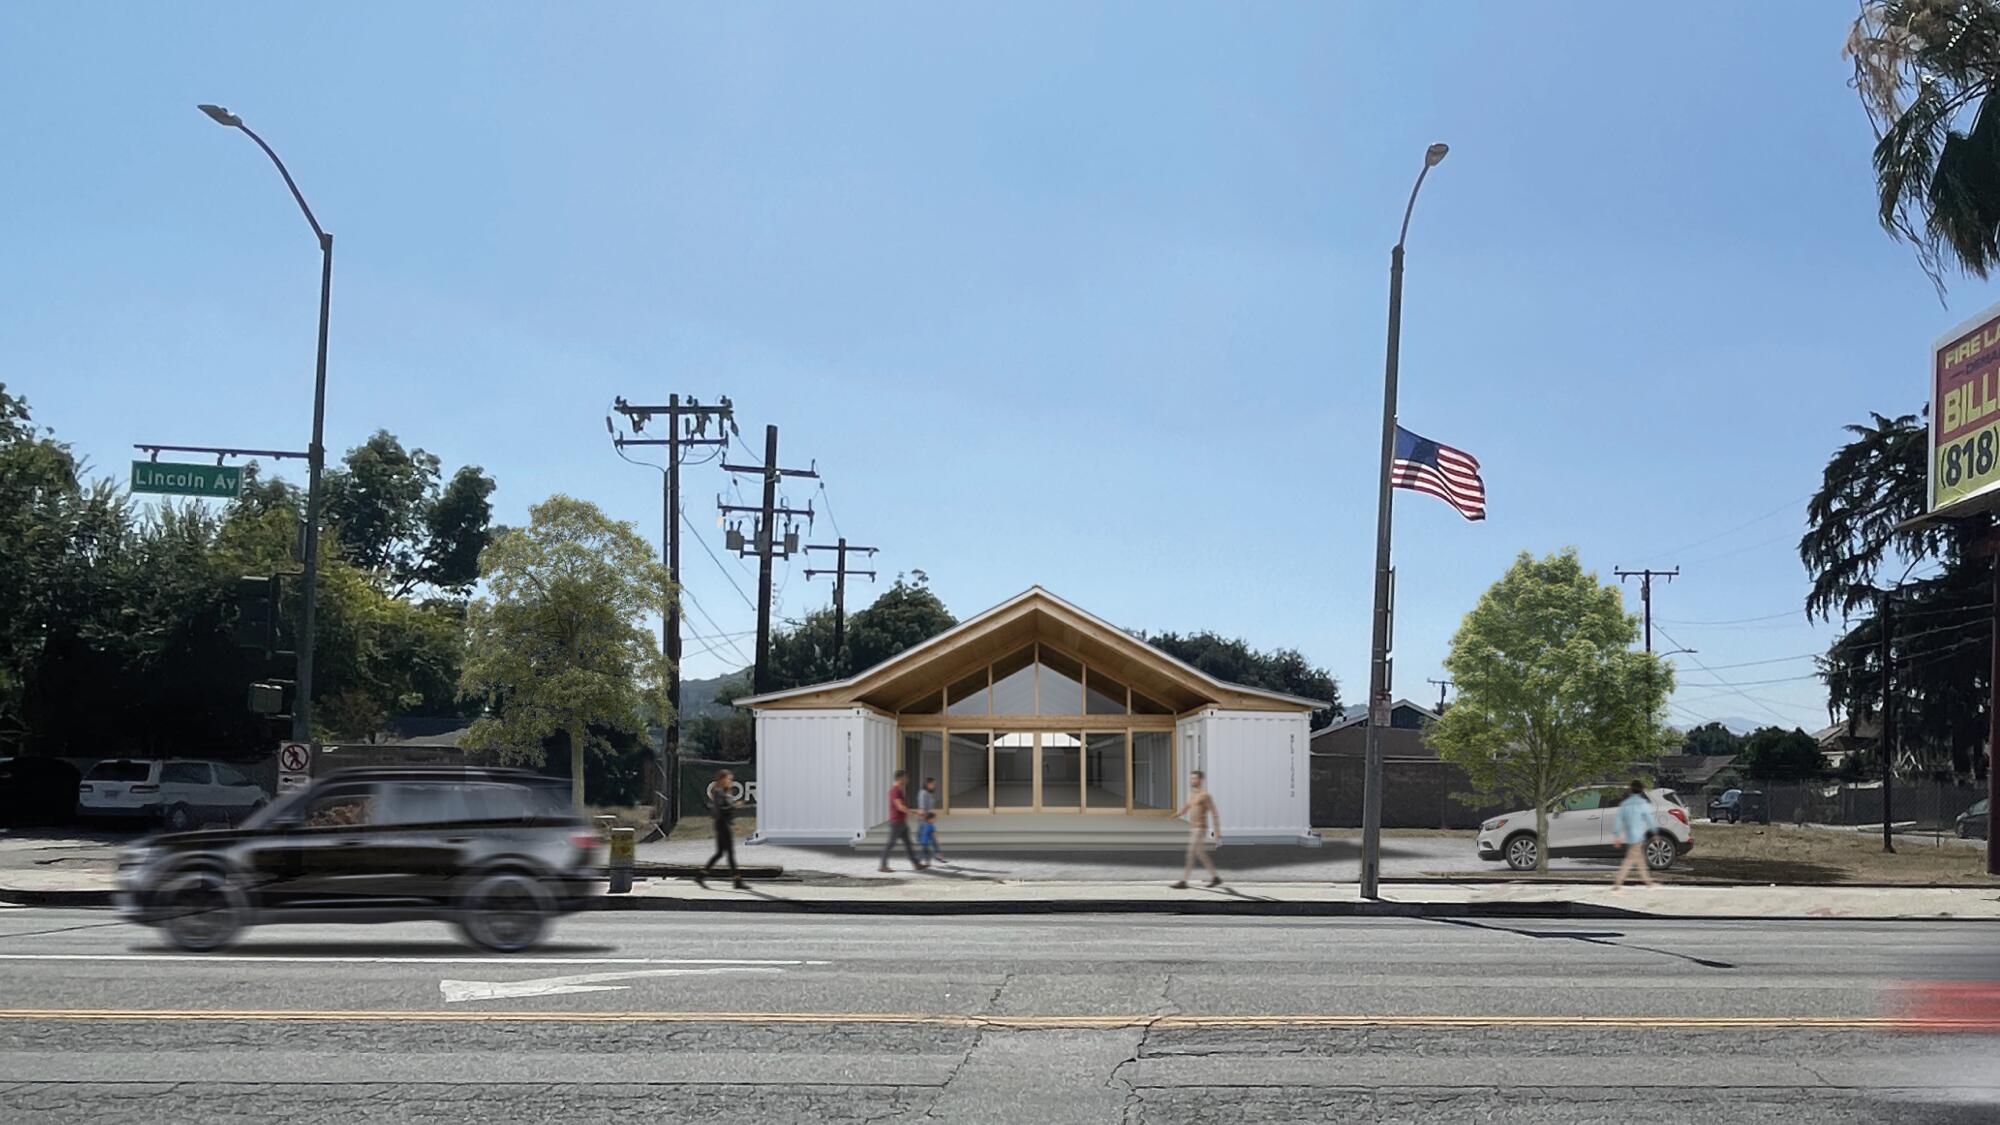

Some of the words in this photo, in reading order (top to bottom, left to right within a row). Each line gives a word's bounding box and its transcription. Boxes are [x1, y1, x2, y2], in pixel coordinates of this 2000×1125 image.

[1945, 333, 1981, 370] FIRE
[1943, 367, 2000, 434] BILL
[136, 468, 204, 489] Lincoln
[213, 473, 237, 490] Av
[1940, 425, 1999, 489] (818)
